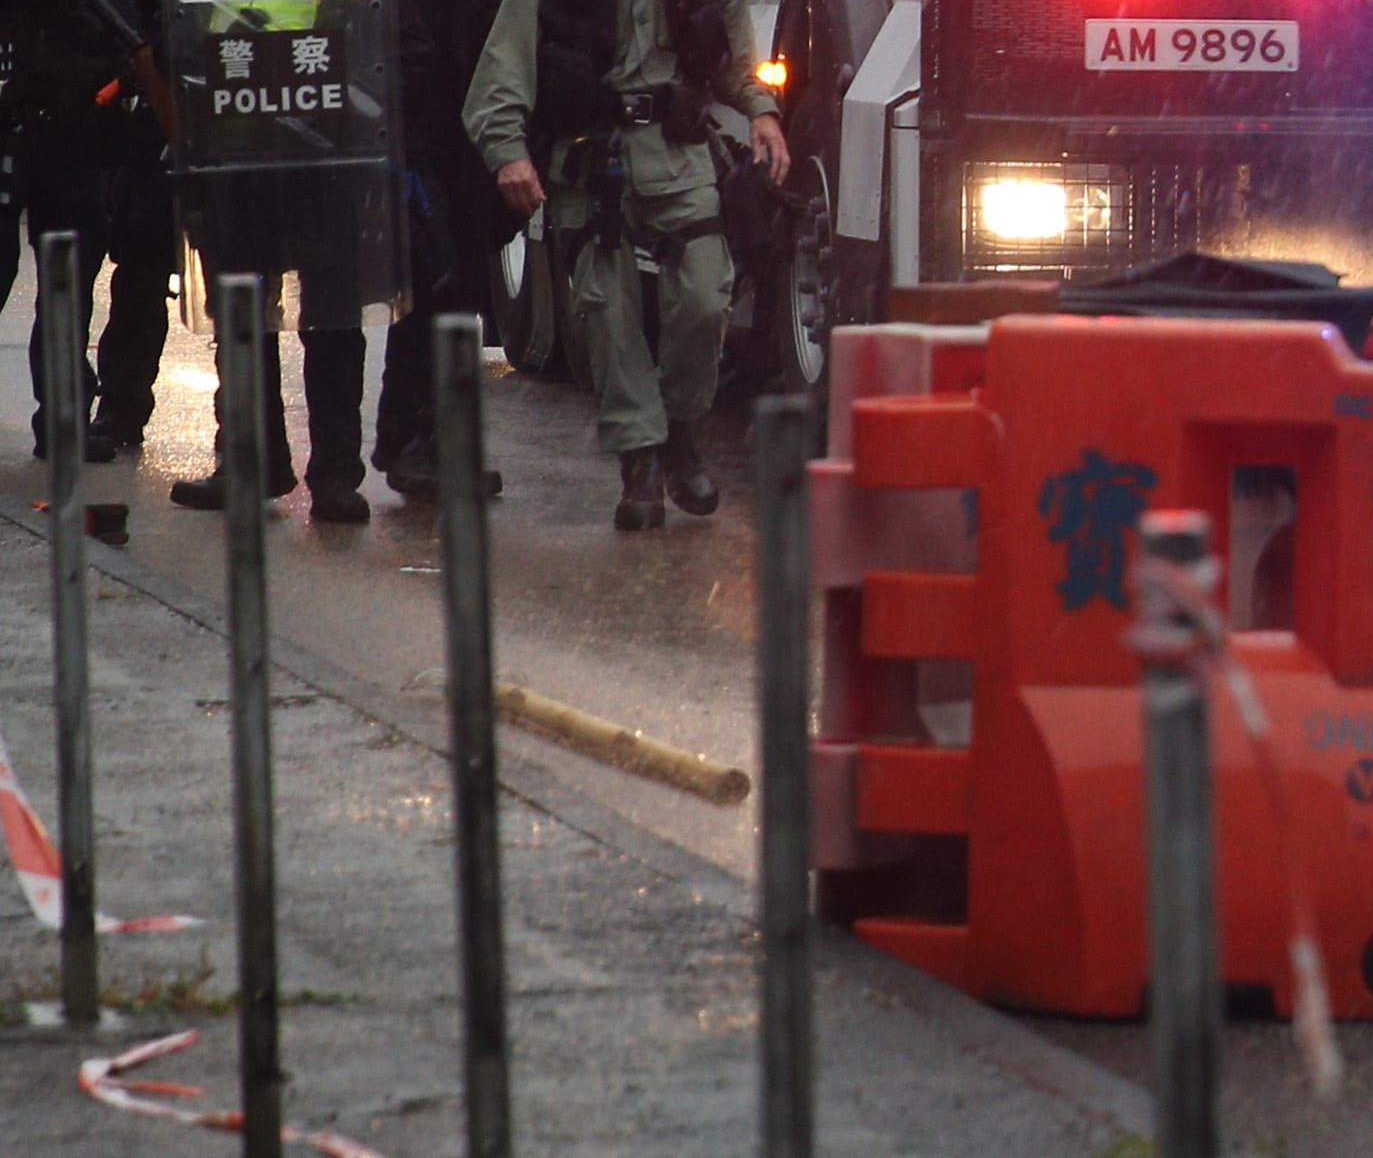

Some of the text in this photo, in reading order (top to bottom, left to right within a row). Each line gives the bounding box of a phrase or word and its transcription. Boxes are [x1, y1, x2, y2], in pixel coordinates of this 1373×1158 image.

[1100, 27, 1286, 63] AM 9896
[213, 83, 343, 115] POLICE
